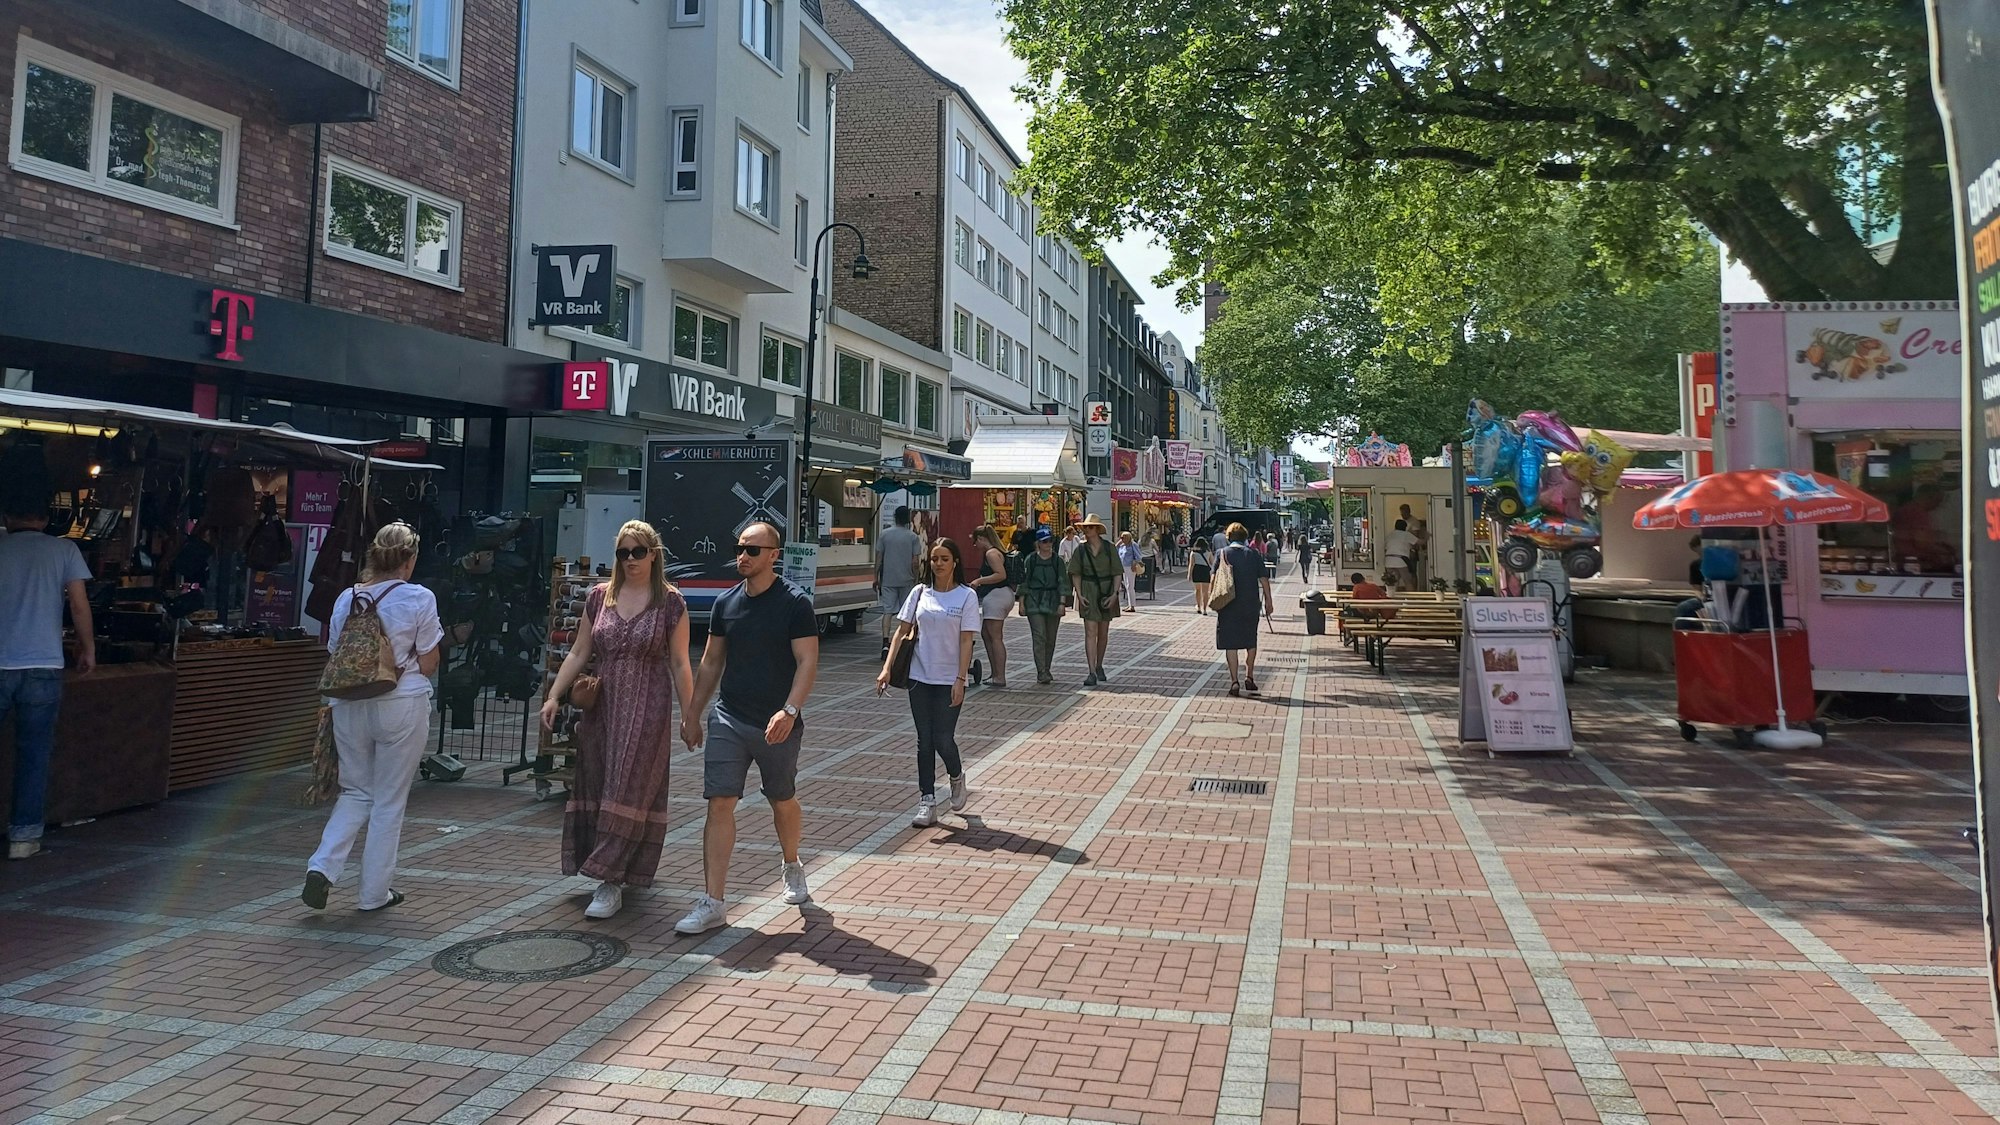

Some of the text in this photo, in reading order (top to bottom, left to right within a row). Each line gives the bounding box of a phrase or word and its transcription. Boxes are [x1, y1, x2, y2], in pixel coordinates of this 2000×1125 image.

[542, 300, 603, 316] VR Bank
[210, 289, 256, 362] T
[572, 370, 597, 400] T
[669, 372, 747, 422] VR Bank
[682, 446, 776, 460] SCHLEMMERHÜTTE
[305, 492, 328, 501] Mehr T
[301, 503, 332, 512] fürs Team
[1476, 608, 1545, 623] Slush-Eis
